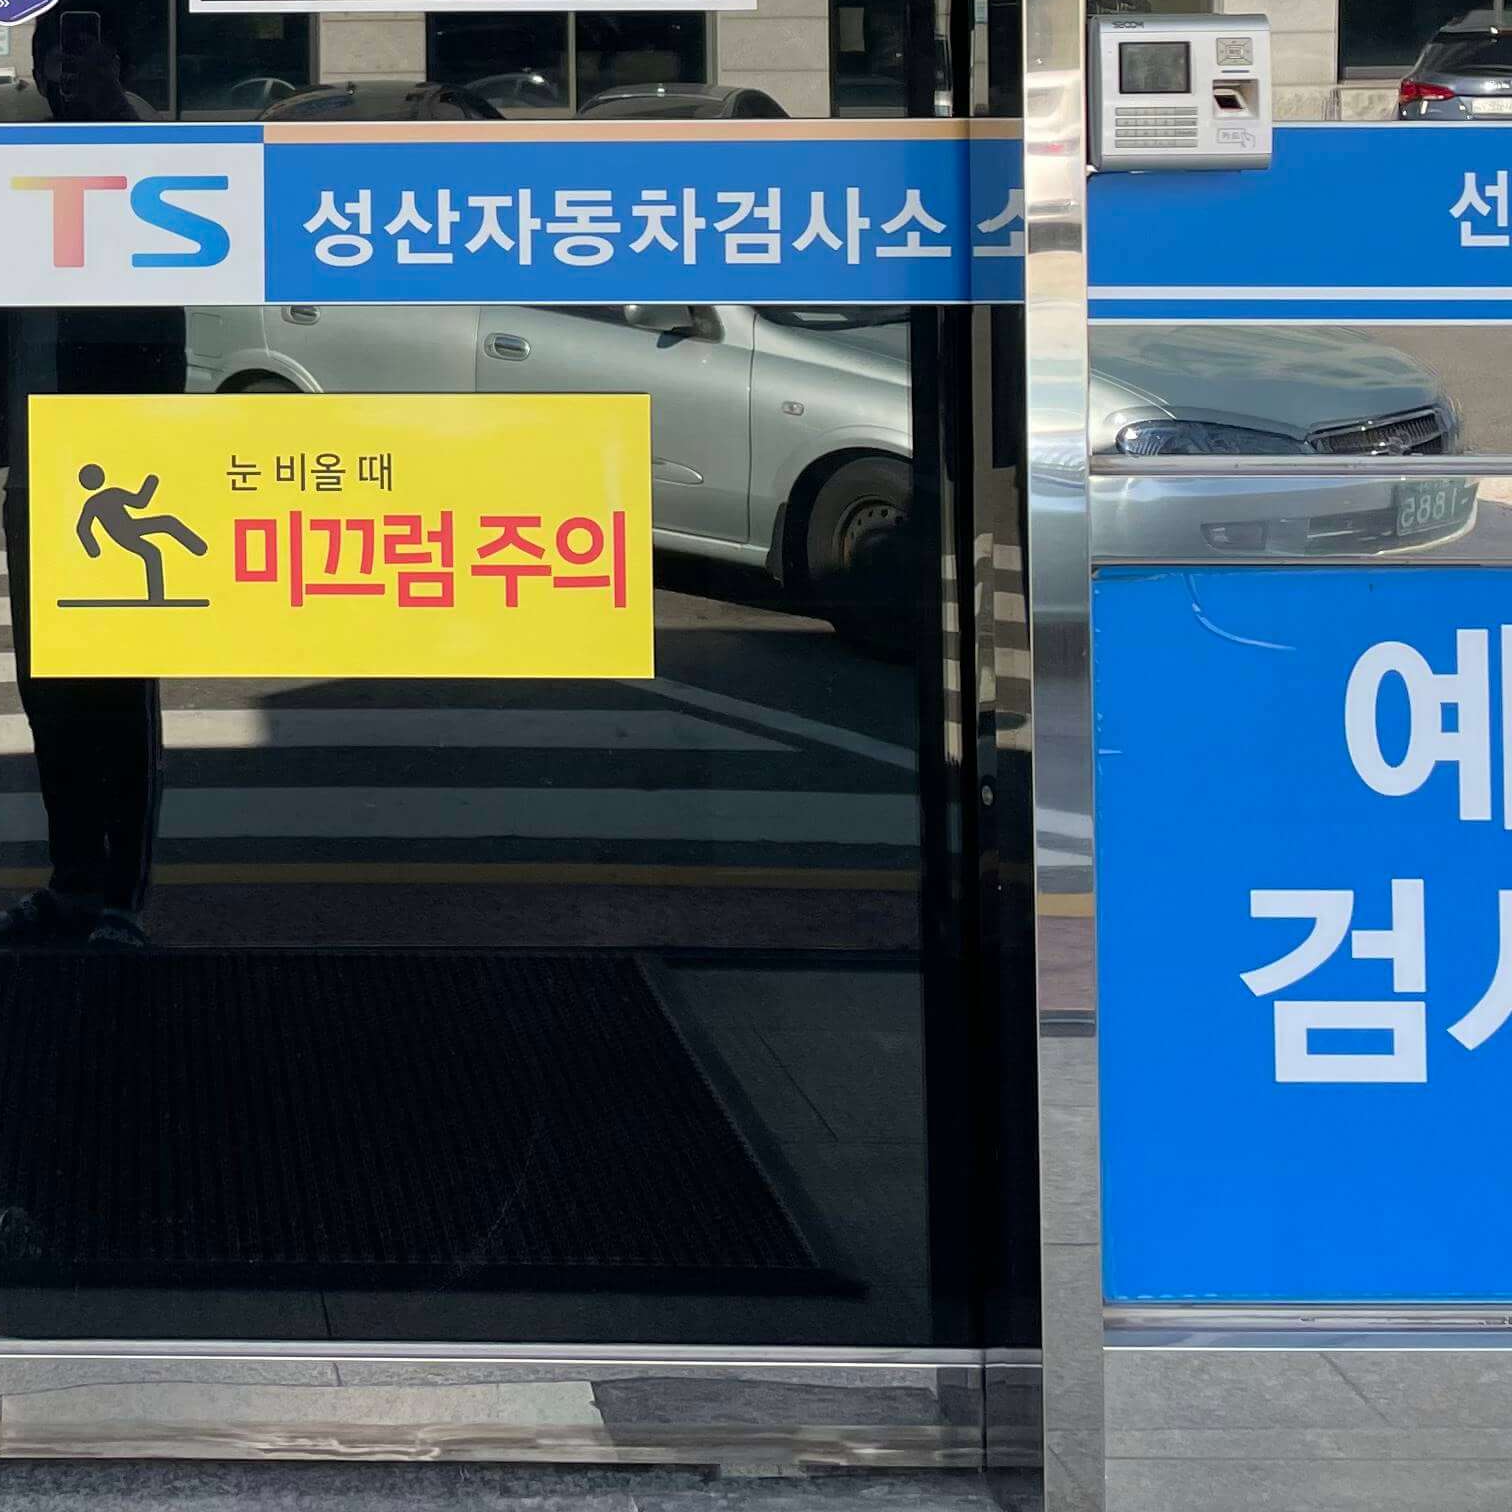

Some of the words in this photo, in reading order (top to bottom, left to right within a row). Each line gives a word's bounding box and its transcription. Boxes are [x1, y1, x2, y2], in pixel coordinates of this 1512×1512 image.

[10, 174, 231, 268] TS
[302, 184, 953, 268] 성산자동차검사소
[1449, 170, 1510, 247] 선
[226, 454, 261, 491] 눈
[358, 452, 393, 491] 때
[1344, 625, 1512, 830] 예
[1239, 879, 1512, 1083] 검
